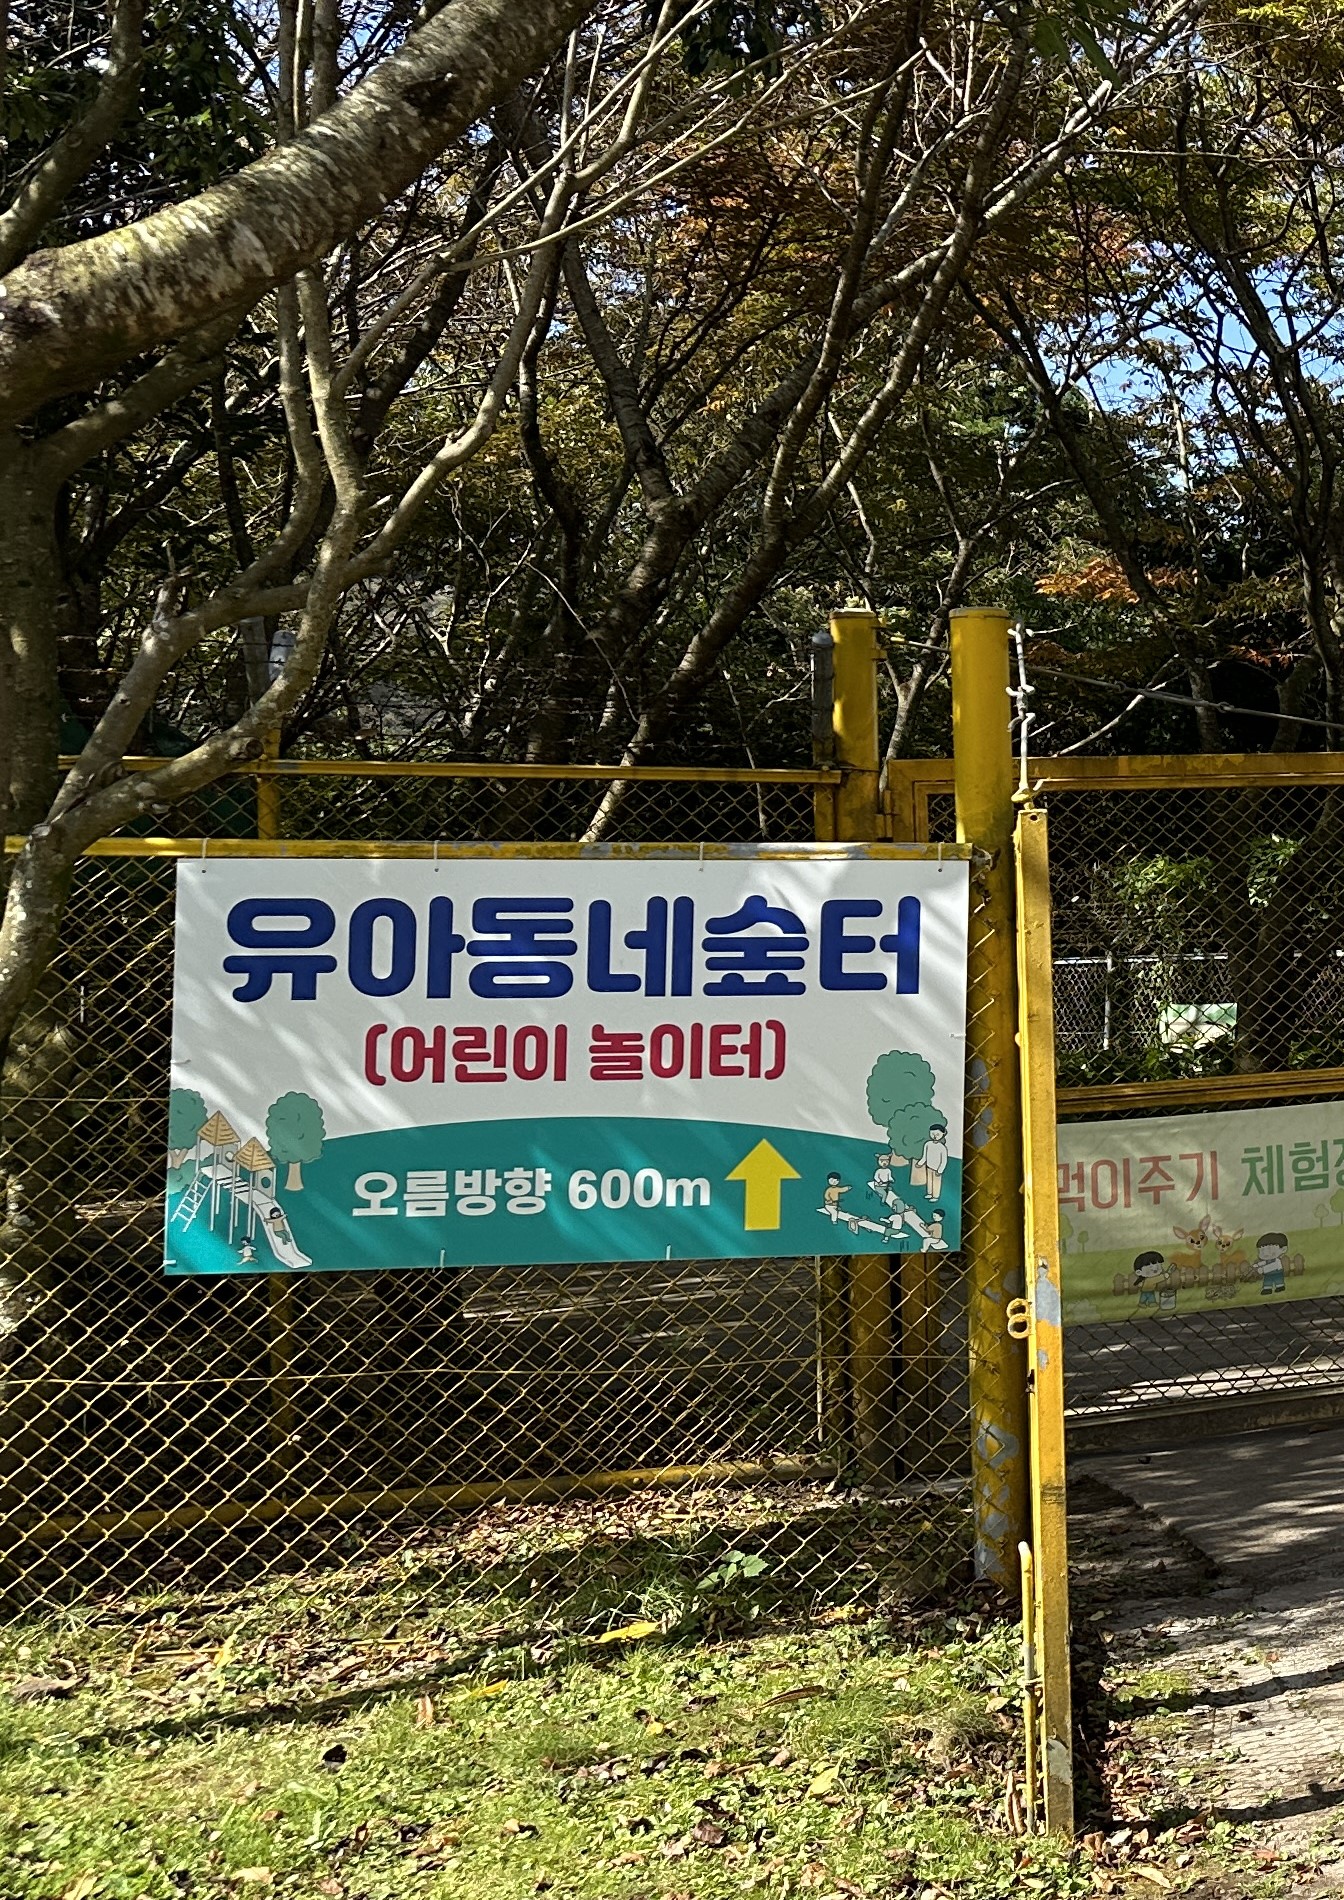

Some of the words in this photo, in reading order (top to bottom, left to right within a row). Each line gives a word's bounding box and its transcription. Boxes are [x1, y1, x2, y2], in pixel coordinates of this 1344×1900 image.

[223, 894, 921, 1003] 유아동네숲터
[364, 1023, 568, 1087] (어린이
[589, 1019, 787, 1082] 놀이터)
[352, 1167, 552, 1219] 오름방향
[567, 1168, 711, 1212] 600m
[1057, 1150, 1220, 1214] 먹이주기
